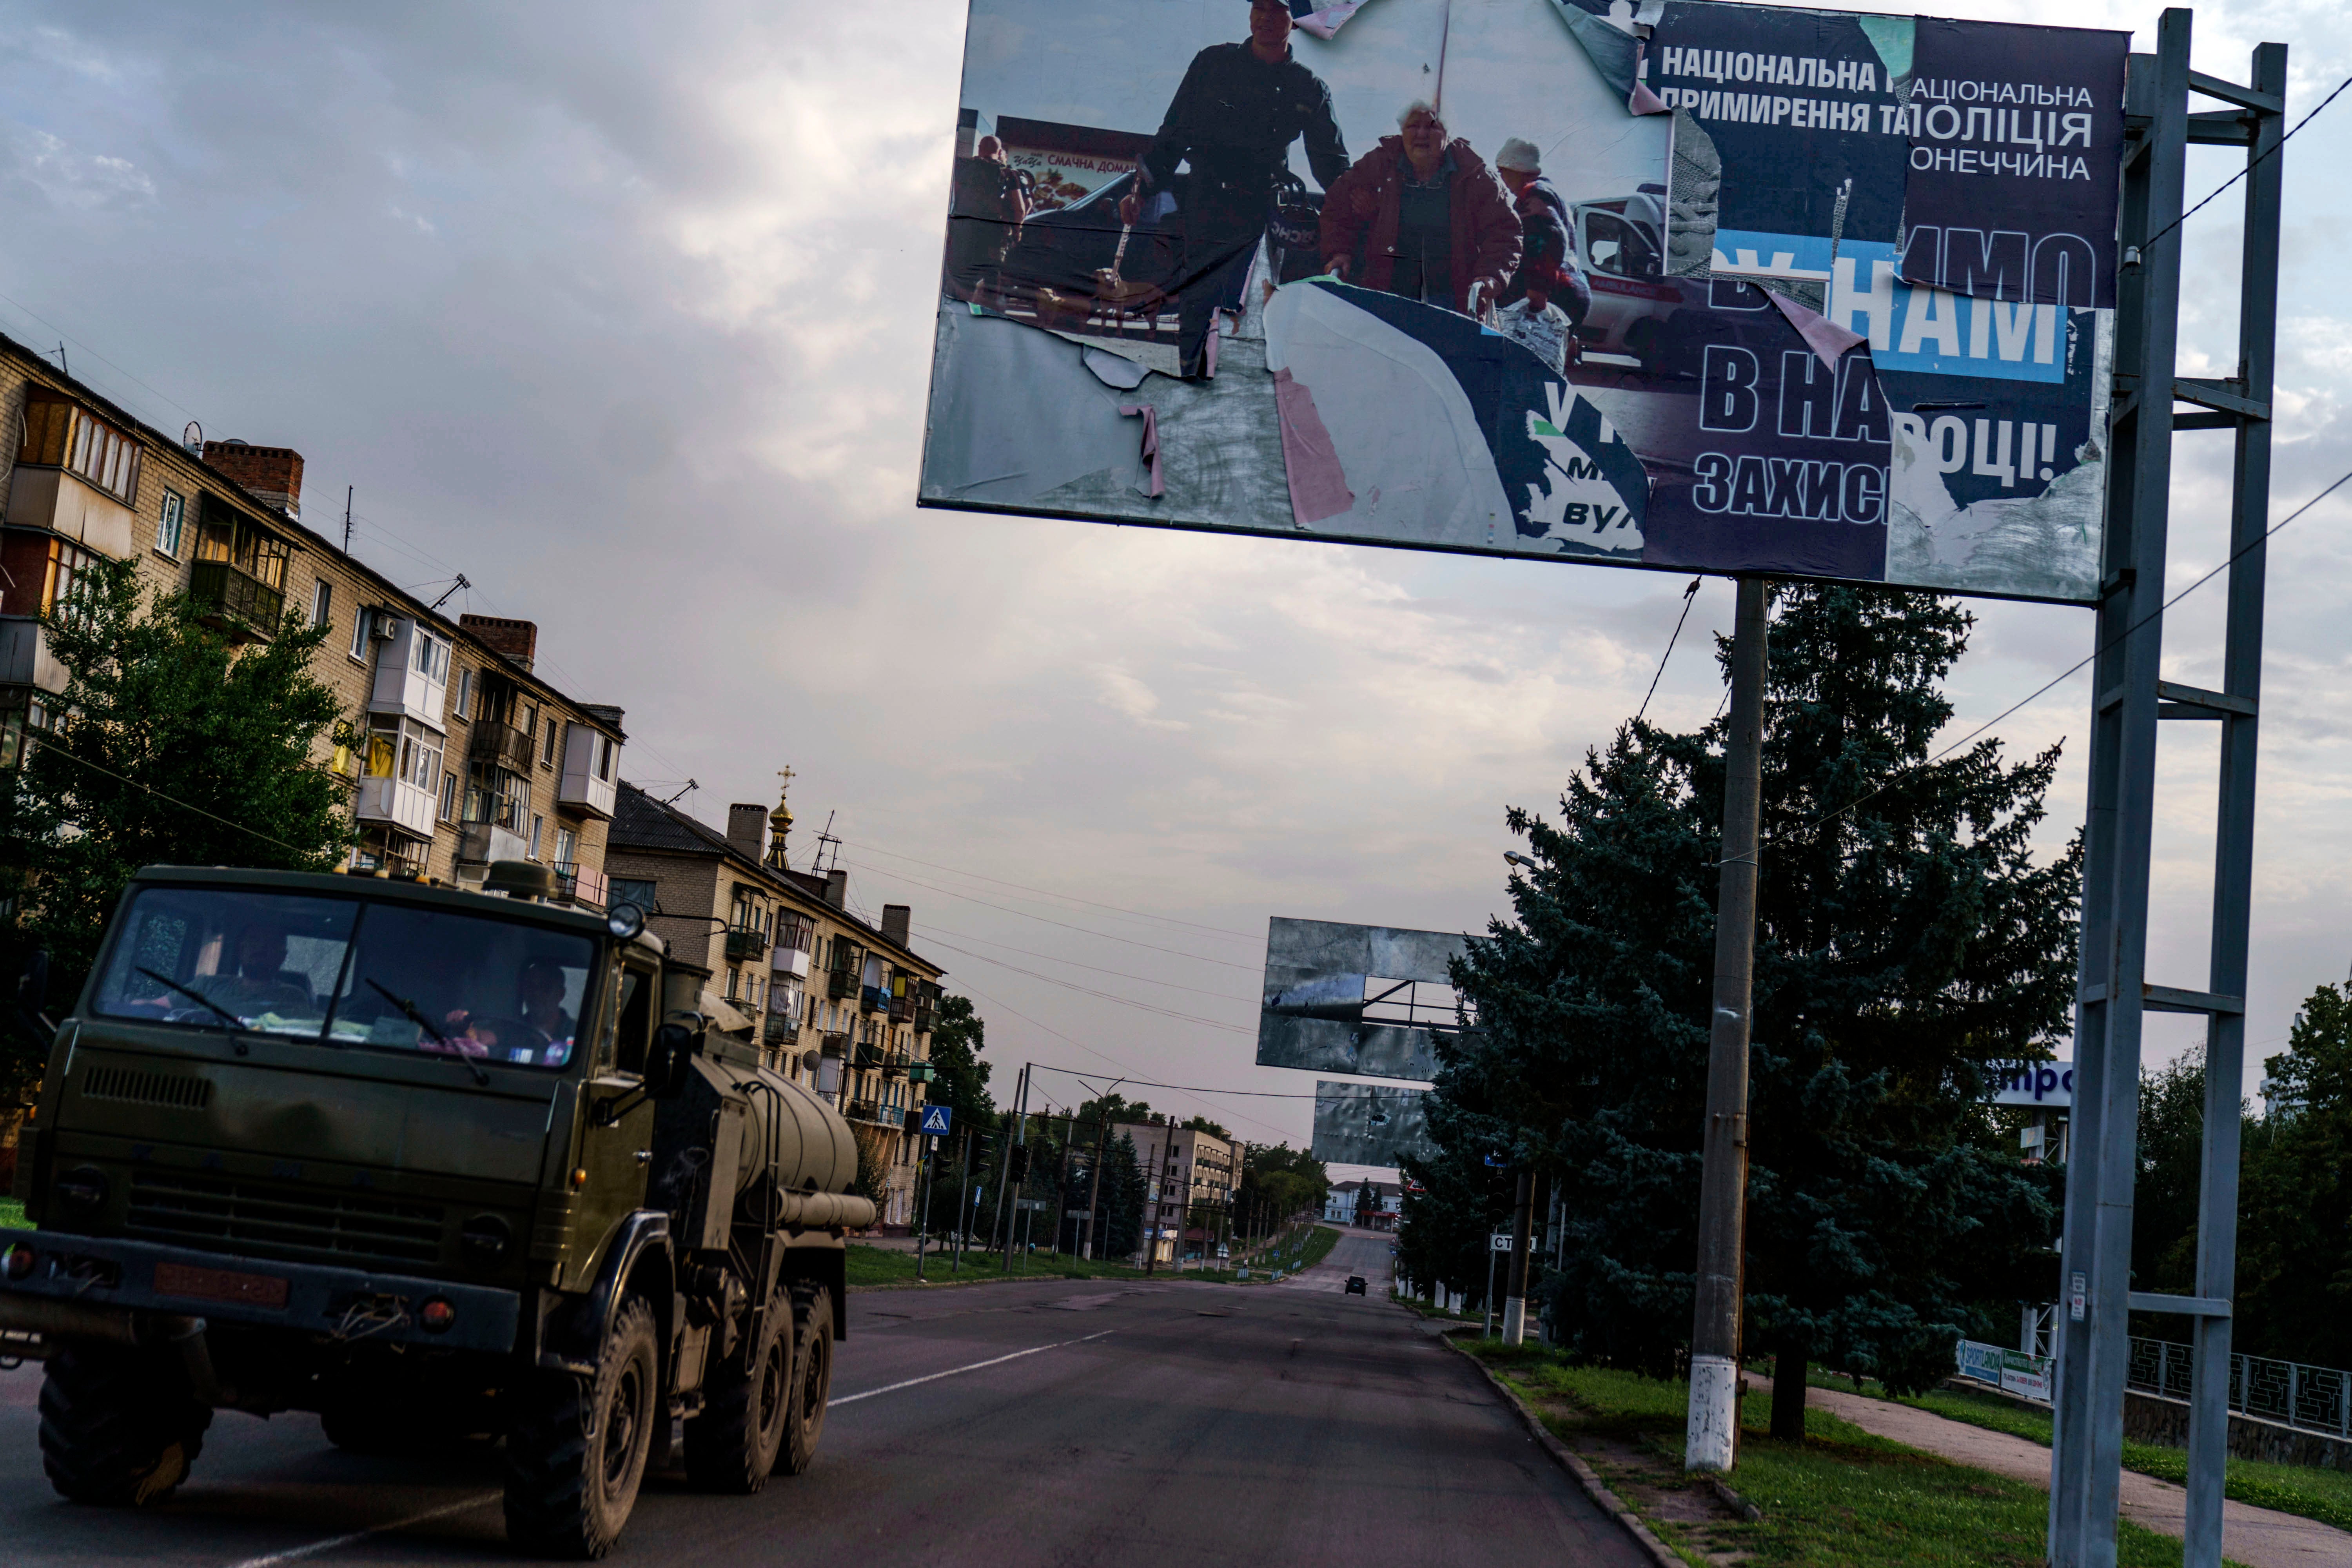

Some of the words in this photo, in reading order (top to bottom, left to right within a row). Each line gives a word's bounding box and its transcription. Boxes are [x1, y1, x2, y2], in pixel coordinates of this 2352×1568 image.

[1662, 46, 1876, 93] НАЦІОНАЛЬНА
[1660, 87, 1871, 132] ПРИМИРЕННЯ
[1047, 154, 1094, 170] СМАЧНА
[1700, 345, 1760, 433] В
[1693, 452, 1891, 525] ЗАХИС
[1495, 1237, 1533, 1250] СТ
